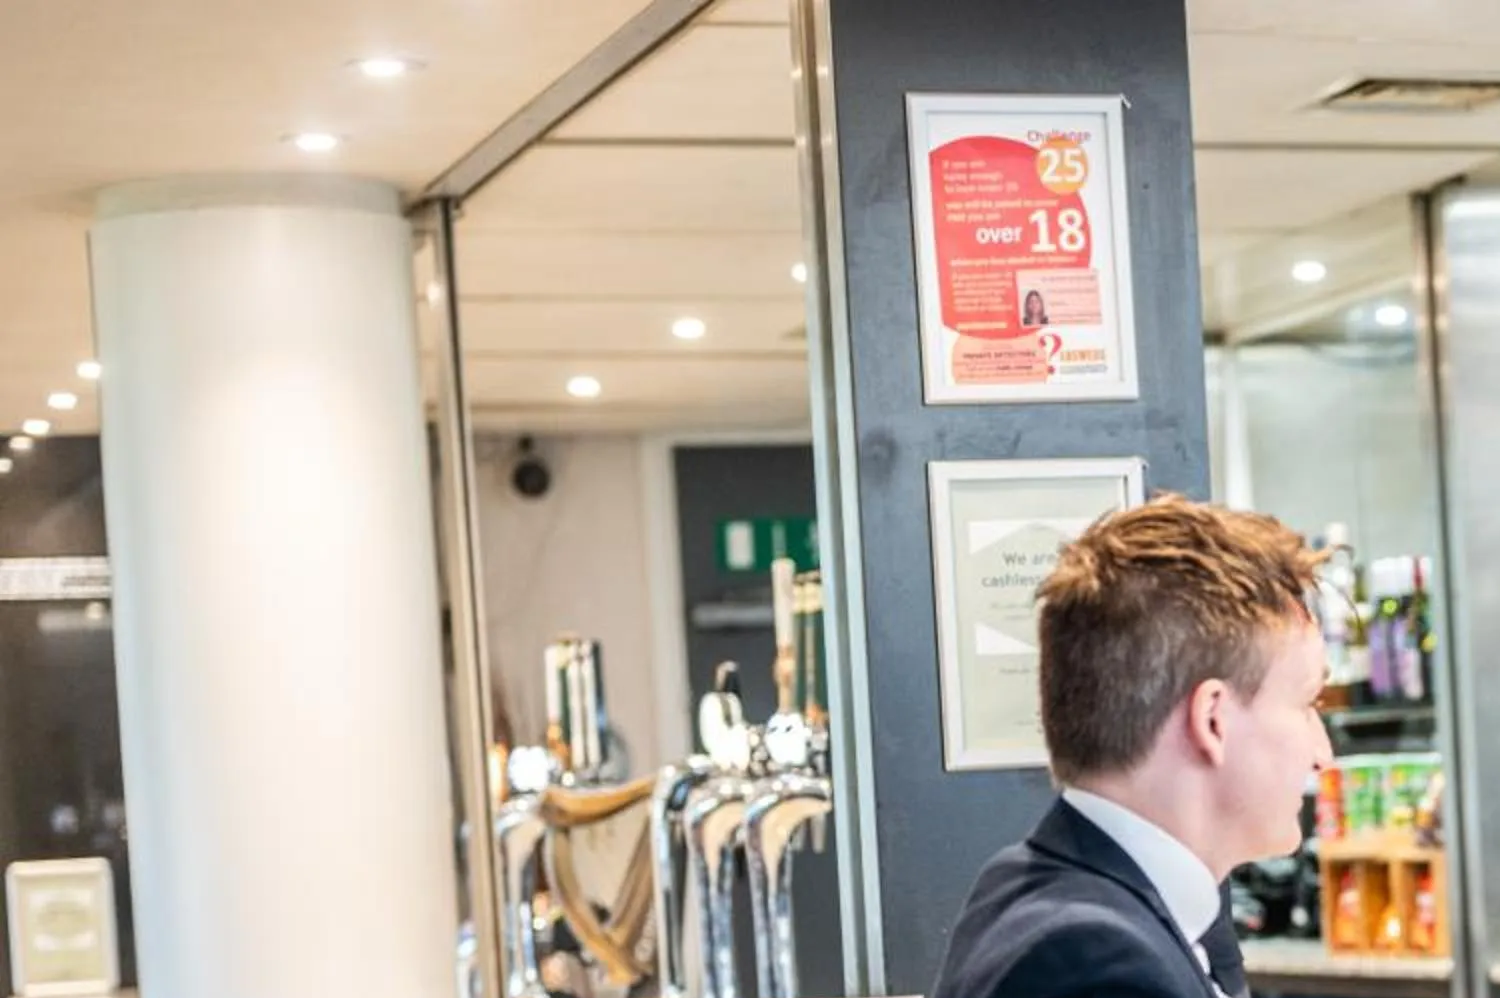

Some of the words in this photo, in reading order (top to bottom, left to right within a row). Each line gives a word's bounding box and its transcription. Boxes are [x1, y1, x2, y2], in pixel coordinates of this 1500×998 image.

[1040, 149, 1084, 182] 25
[976, 227, 1022, 245] over
[1028, 208, 1085, 252] 18
[1002, 551, 1026, 567] We
